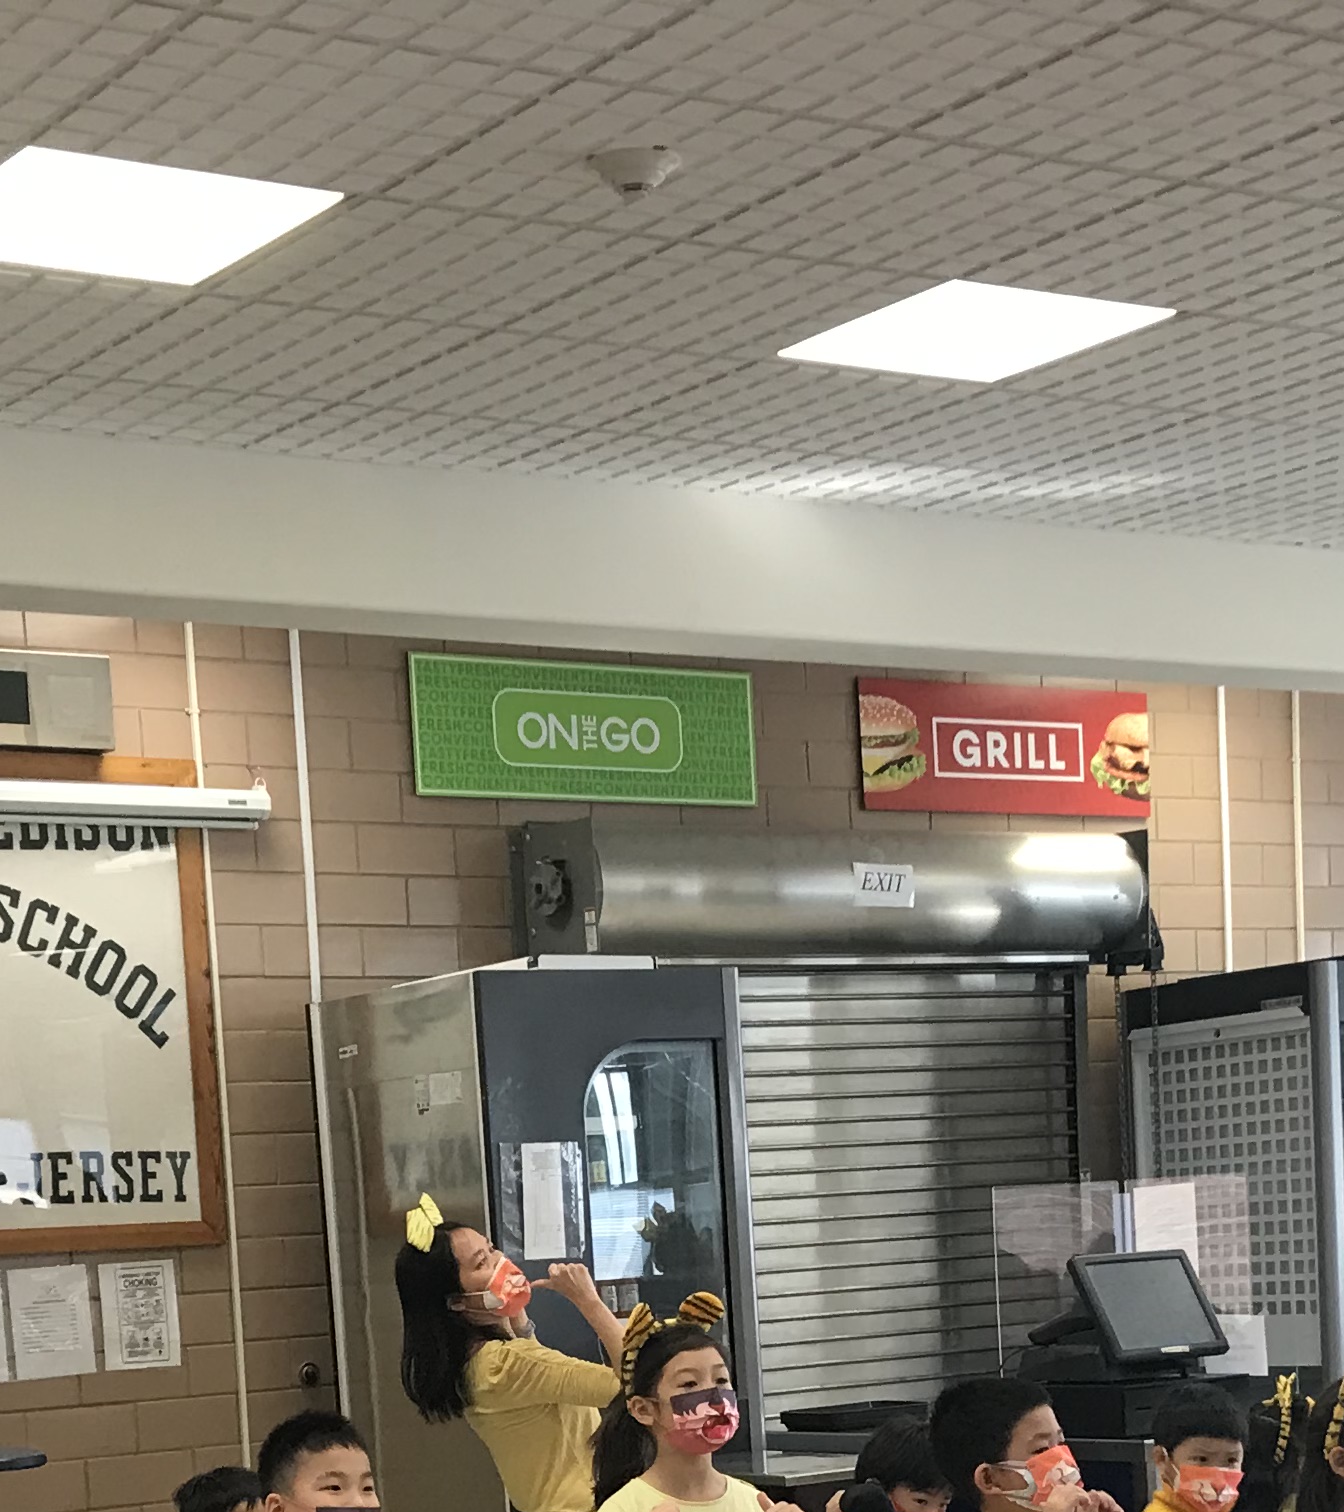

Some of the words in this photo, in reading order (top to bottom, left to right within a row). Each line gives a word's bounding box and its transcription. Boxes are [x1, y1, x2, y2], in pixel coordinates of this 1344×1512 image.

[517, 712, 579, 750] ON
[581, 714, 599, 751] THE
[600, 716, 660, 754] GO
[952, 729, 1066, 771] GRILL
[860, 871, 906, 893] EXIT
[15, 1150, 192, 1205] JERSEY
[123, 1278, 158, 1289] CHOKING
